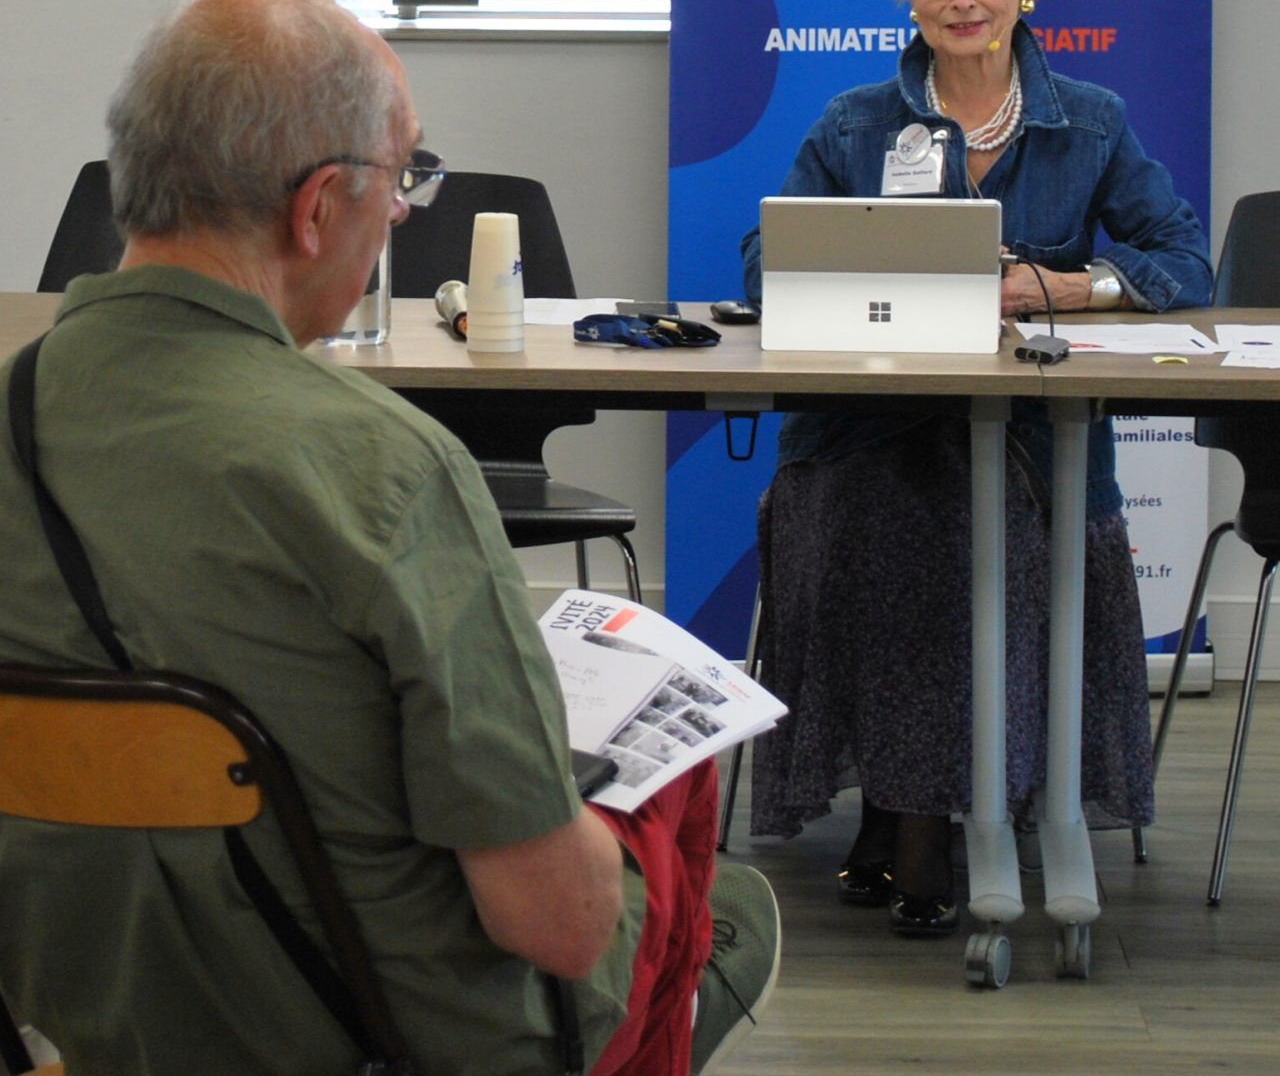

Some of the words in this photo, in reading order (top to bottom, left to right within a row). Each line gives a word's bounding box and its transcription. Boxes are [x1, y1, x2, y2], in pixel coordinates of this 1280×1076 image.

[764, 27, 915, 52] ANIMATEU
[1113, 429, 1194, 443] amiliales
[1124, 494, 1163, 510] ysées
[1134, 564, 1173, 579] 91.fr
[549, 599, 594, 630] IVITÉ
[575, 605, 617, 632] 2024
